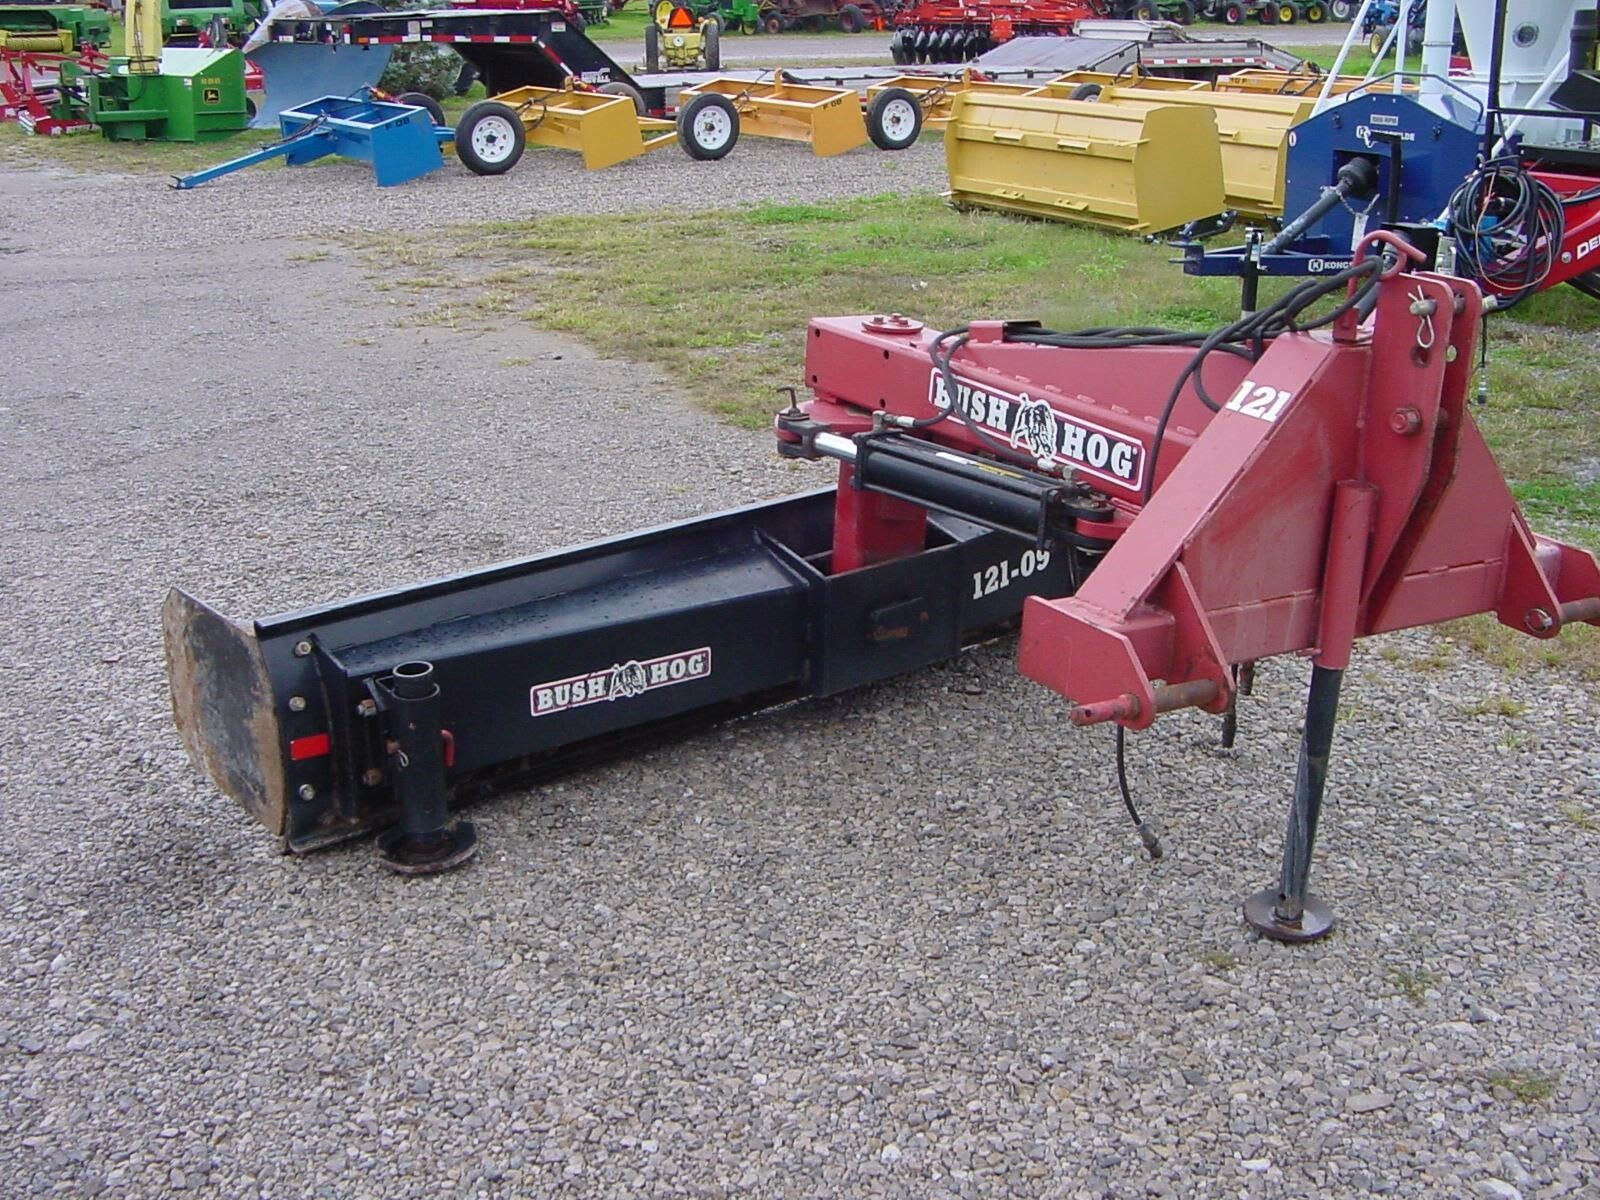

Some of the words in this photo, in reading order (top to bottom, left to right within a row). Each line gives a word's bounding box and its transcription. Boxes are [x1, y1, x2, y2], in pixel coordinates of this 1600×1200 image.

[1577, 234, 1600, 260] DE
[1225, 379, 1292, 422] 121
[934, 376, 1010, 432] BUSH
[1062, 424, 1134, 479] HOG
[972, 549, 1050, 600] 121-09
[537, 676, 606, 710] BUSH
[651, 654, 704, 684] HOG
